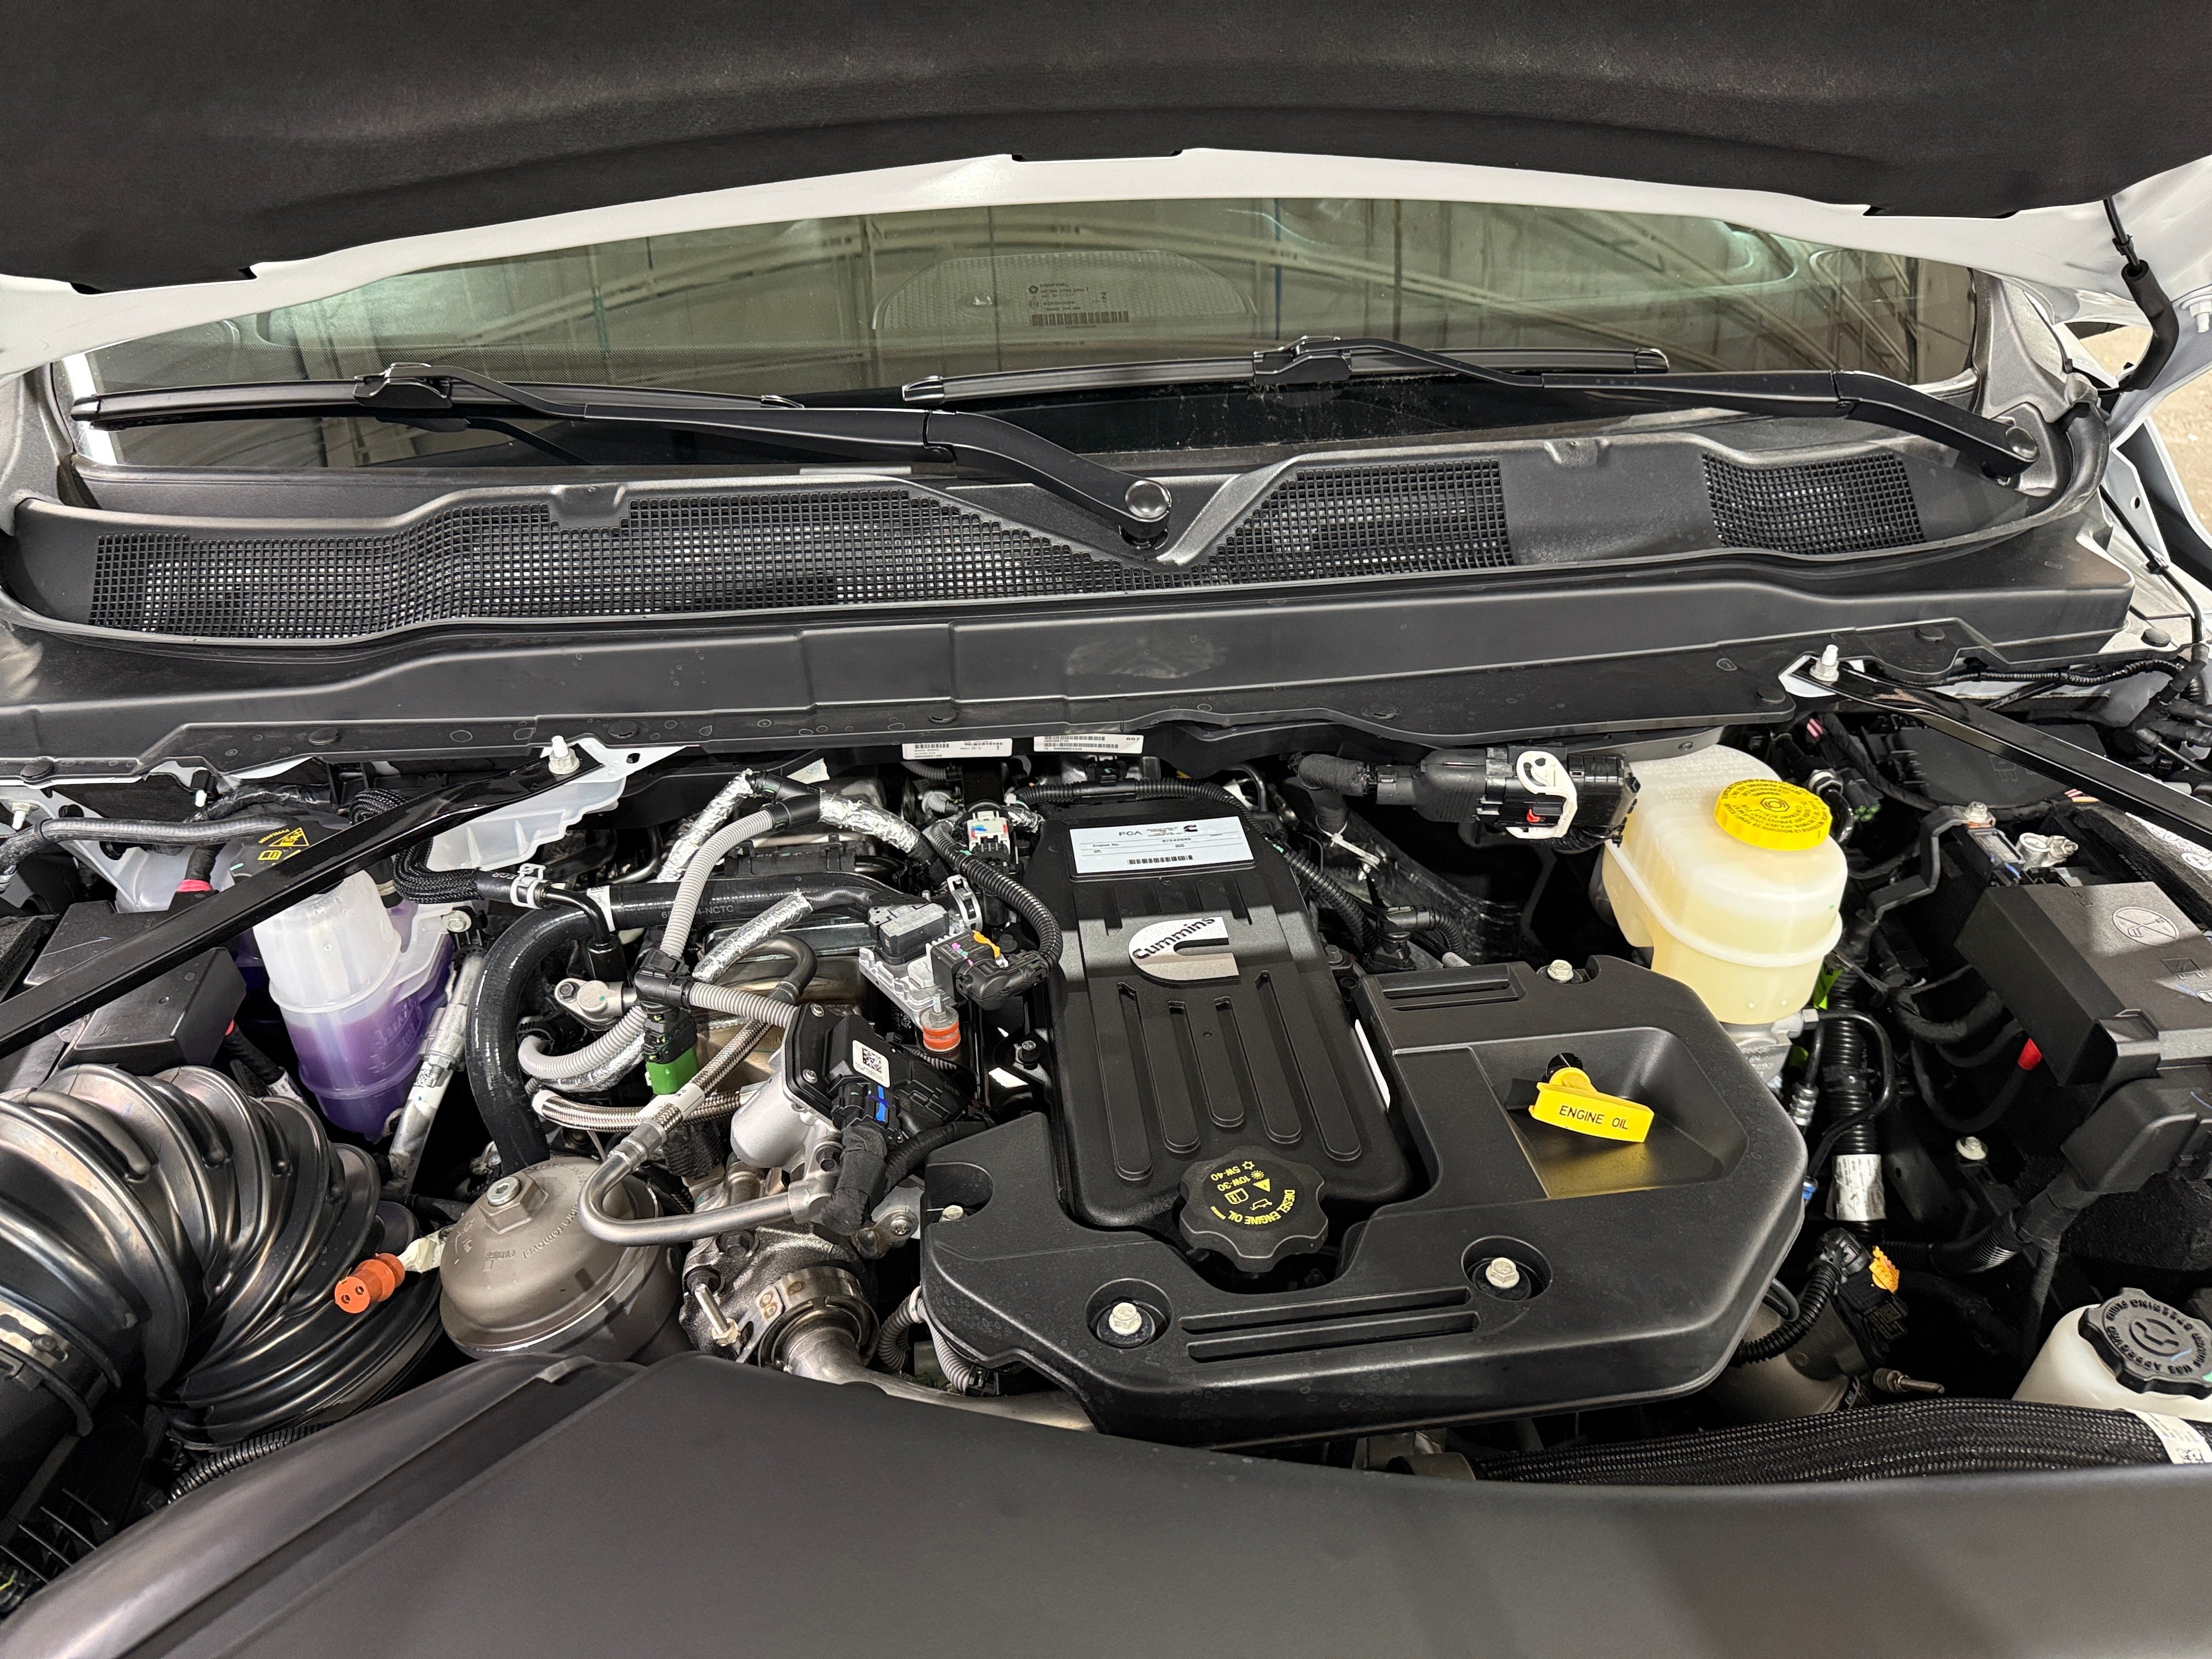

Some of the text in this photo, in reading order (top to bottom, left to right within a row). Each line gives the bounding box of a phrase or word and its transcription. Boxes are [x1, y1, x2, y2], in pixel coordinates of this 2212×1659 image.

[1132, 917, 1215, 960] Cummins
[1559, 1105, 1628, 1130] ENGINE OIL
[1210, 1166, 1241, 1181] 5W-40
[1217, 1175, 1251, 1192] 10W-30
[1276, 1189, 1295, 1214] DIESEL
[1228, 1210, 1243, 1223] OIL
[1244, 1211, 1282, 1224] ENGINE
[522, 1226, 566, 1259] removal
